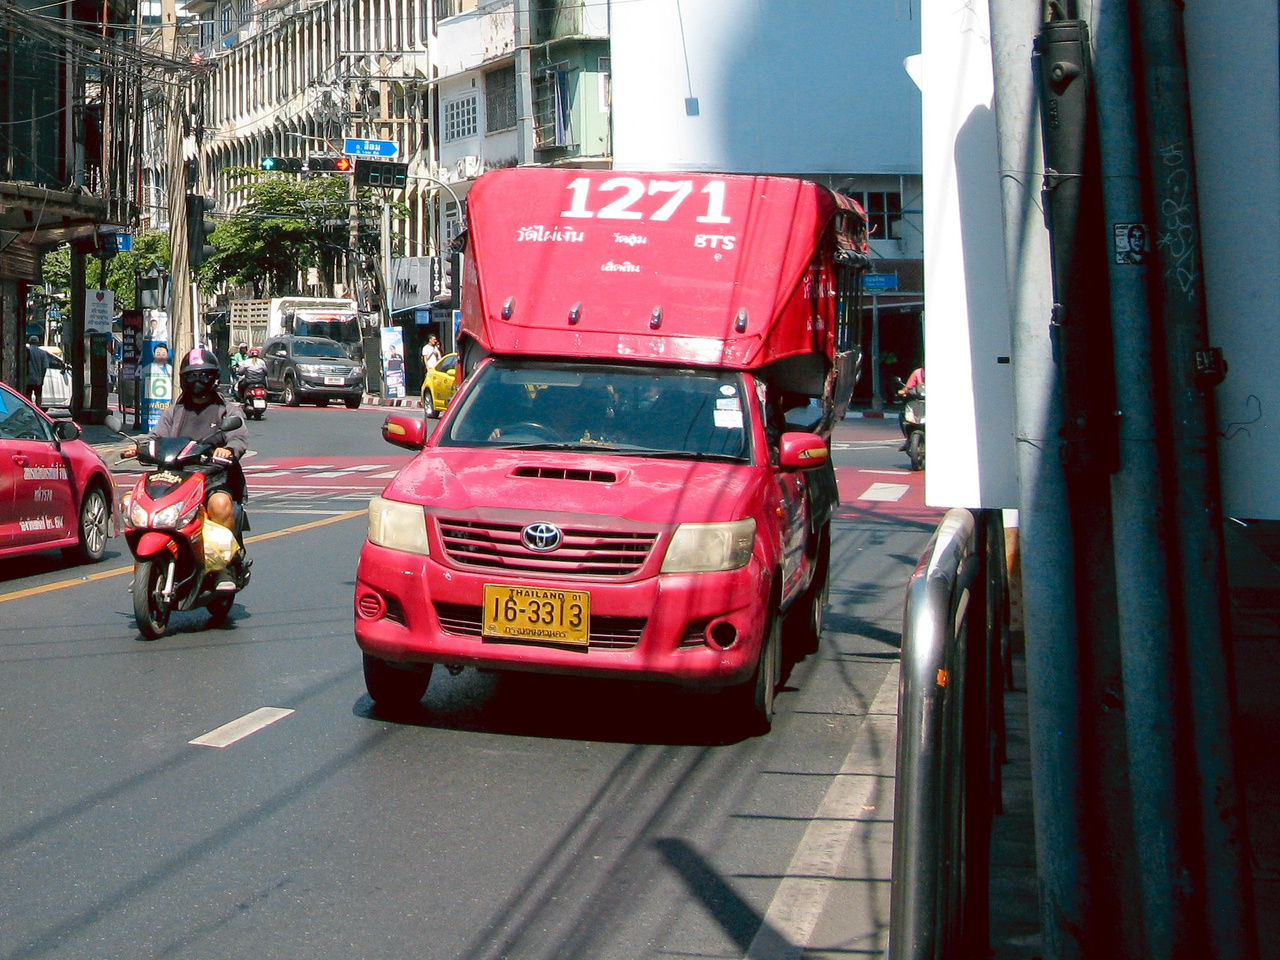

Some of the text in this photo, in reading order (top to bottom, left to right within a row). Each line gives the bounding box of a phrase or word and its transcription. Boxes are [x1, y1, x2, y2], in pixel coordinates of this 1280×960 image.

[363, 141, 381, 151] สีลม
[560, 177, 731, 224] 1271
[515, 224, 584, 242] วัดไผ่เงิน
[694, 234, 736, 250] BTS
[152, 378, 168, 398] 6
[509, 589, 565, 600] THAILAND
[493, 597, 583, 628] 16-3313
